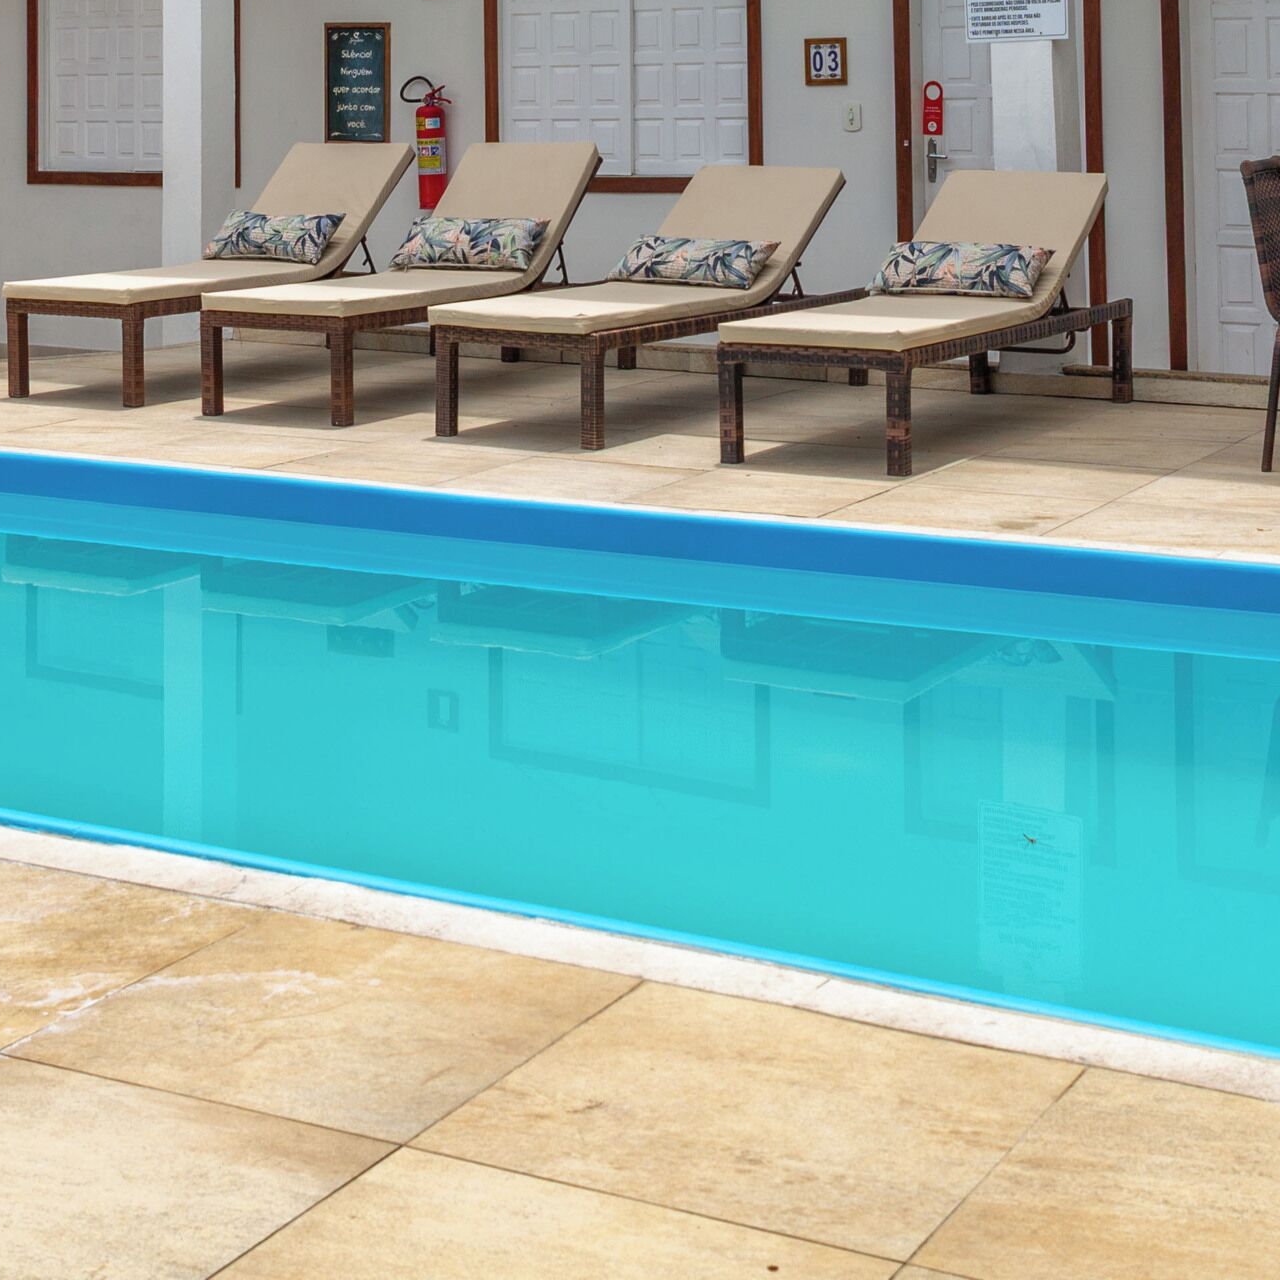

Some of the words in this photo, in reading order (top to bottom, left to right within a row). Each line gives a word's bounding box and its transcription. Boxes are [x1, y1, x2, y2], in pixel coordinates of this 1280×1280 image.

[812, 50, 839, 73] 03
[340, 67, 373, 78] Ninguém
[333, 87, 349, 96] quer
[352, 86, 380, 94] acordar
[336, 102, 358, 112] junto
